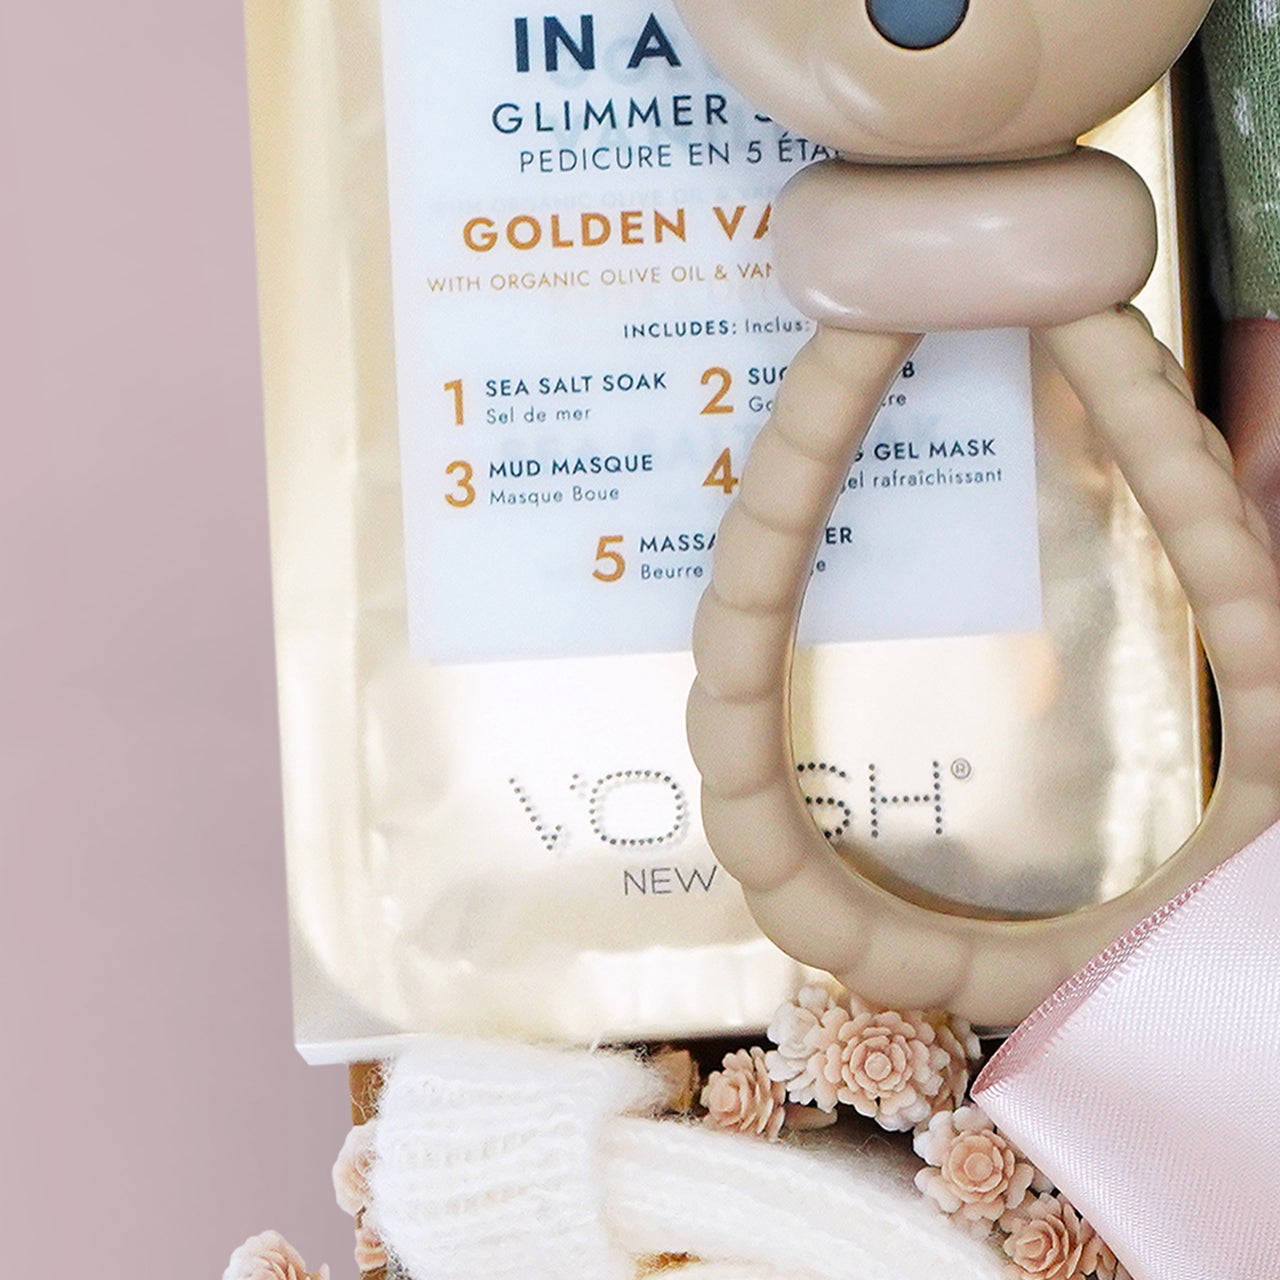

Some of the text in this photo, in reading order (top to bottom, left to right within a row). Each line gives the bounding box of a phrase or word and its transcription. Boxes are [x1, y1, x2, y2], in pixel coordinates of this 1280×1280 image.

[513, 13, 682, 74] IN A
[491, 94, 729, 135] GLIMMER
[519, 143, 672, 174] PEDICURE
[689, 142, 730, 166] EN
[746, 141, 761, 163] 5
[462, 208, 687, 253] GOLDEN
[427, 275, 480, 294] WITH
[490, 270, 590, 291] ORGANIC
[600, 266, 660, 286] OLIVE
[671, 264, 705, 282] OIL
[714, 264, 728, 280] &
[624, 320, 737, 340] INCLUDES:
[443, 372, 668, 426] 1 SEA SALT SOAK
[700, 366, 734, 415] 2
[486, 405, 592, 425] Sel de mer
[445, 454, 653, 508] 3 MUD MASQUE
[702, 447, 739, 496] 4
[874, 442, 920, 460] GEL
[929, 438, 996, 458] MASK
[873, 468, 1003, 488] rafraîchissant
[490, 486, 620, 507] Masque Boue
[591, 534, 626, 583] 5
[640, 563, 704, 580] Beurre
[623, 865, 719, 896] NEW
